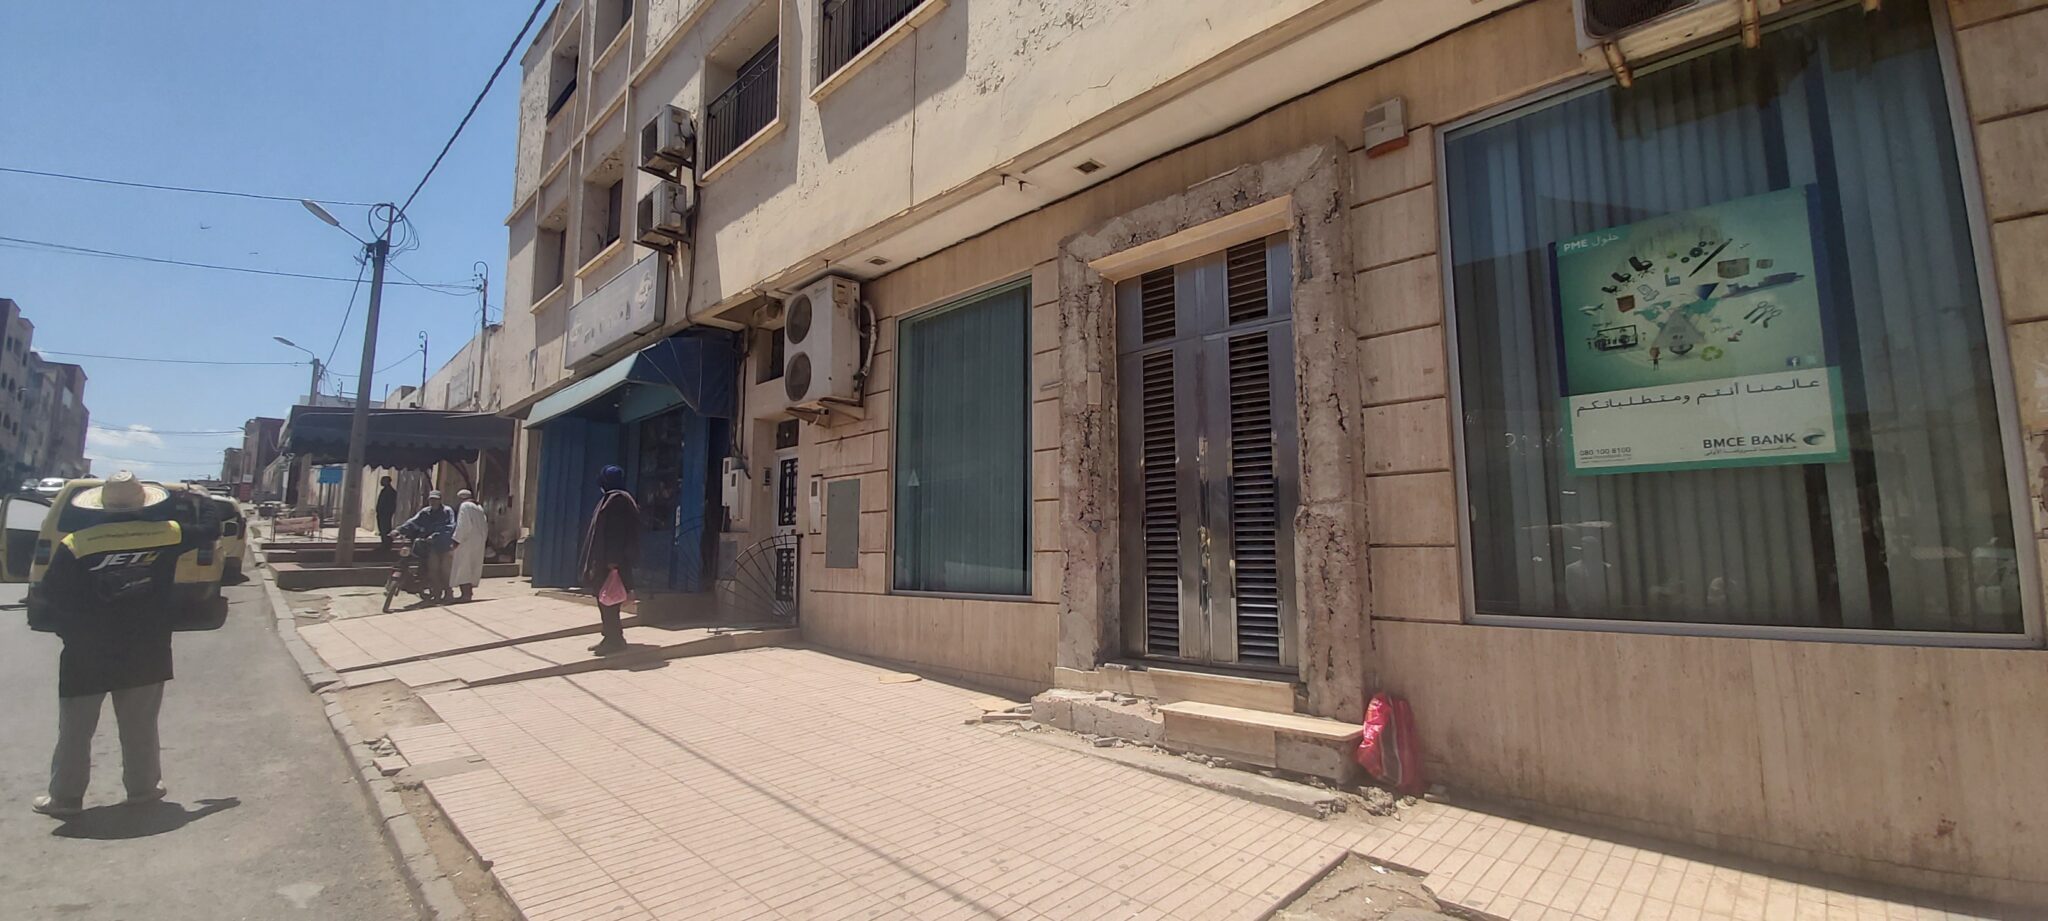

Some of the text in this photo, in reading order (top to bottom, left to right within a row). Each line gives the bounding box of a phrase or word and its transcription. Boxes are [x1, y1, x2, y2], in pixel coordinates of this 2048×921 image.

[1563, 239, 1588, 252] PME
[1696, 382, 1739, 405] أنتم
[1746, 378, 1820, 394] عالمنا
[1702, 431, 1796, 449] BMCE BANK
